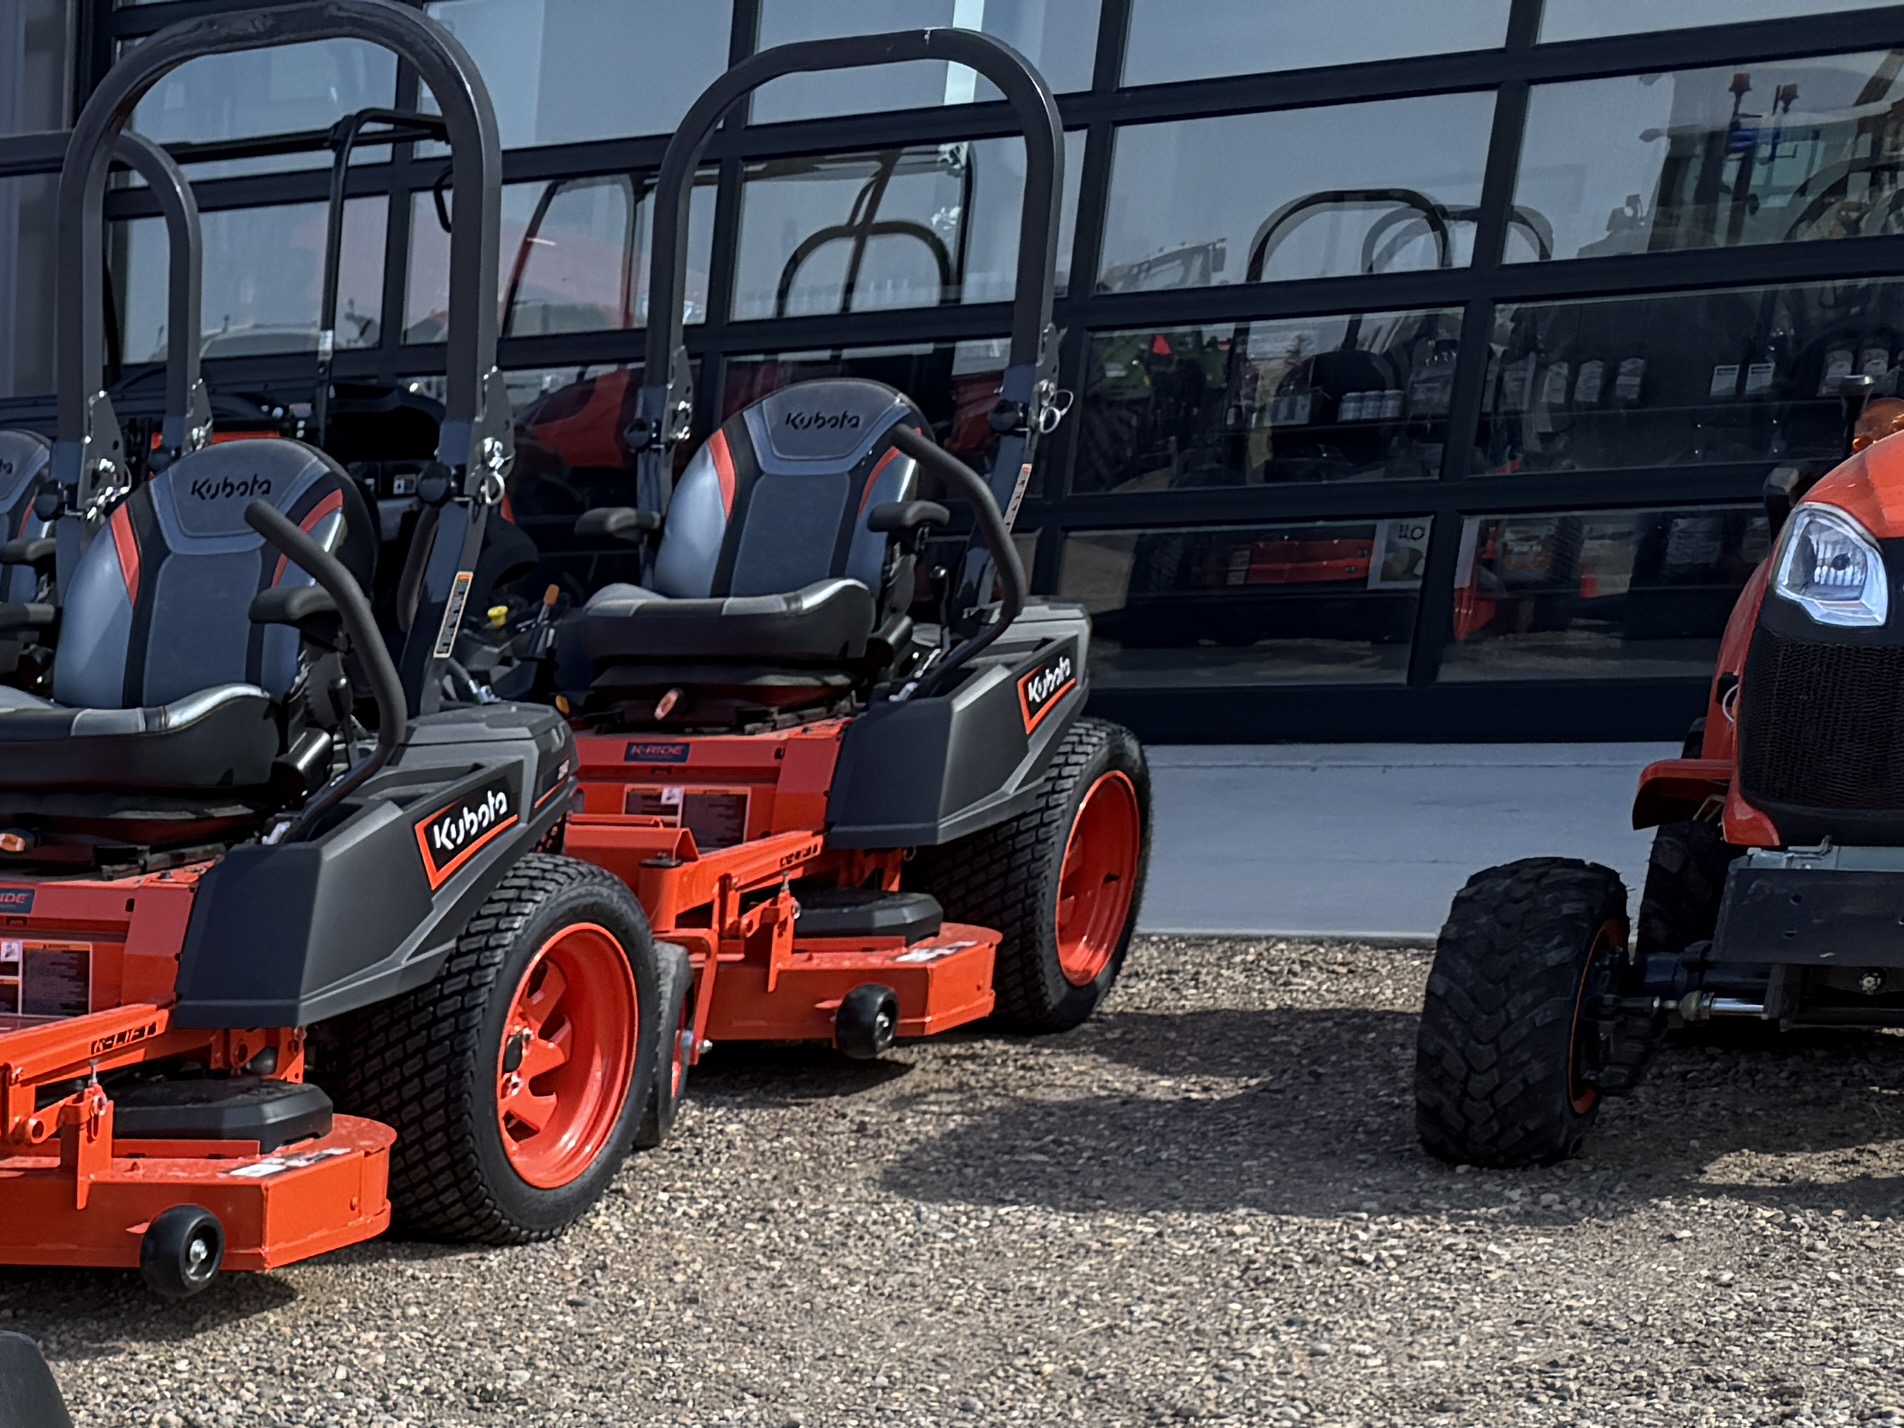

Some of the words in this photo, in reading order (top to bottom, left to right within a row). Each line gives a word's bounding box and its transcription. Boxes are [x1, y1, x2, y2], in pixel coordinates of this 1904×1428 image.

[784, 410, 861, 431] Kubota
[190, 475, 273, 501] Kubota
[1028, 656, 1071, 703] Kubota
[433, 790, 508, 850] Kubota
